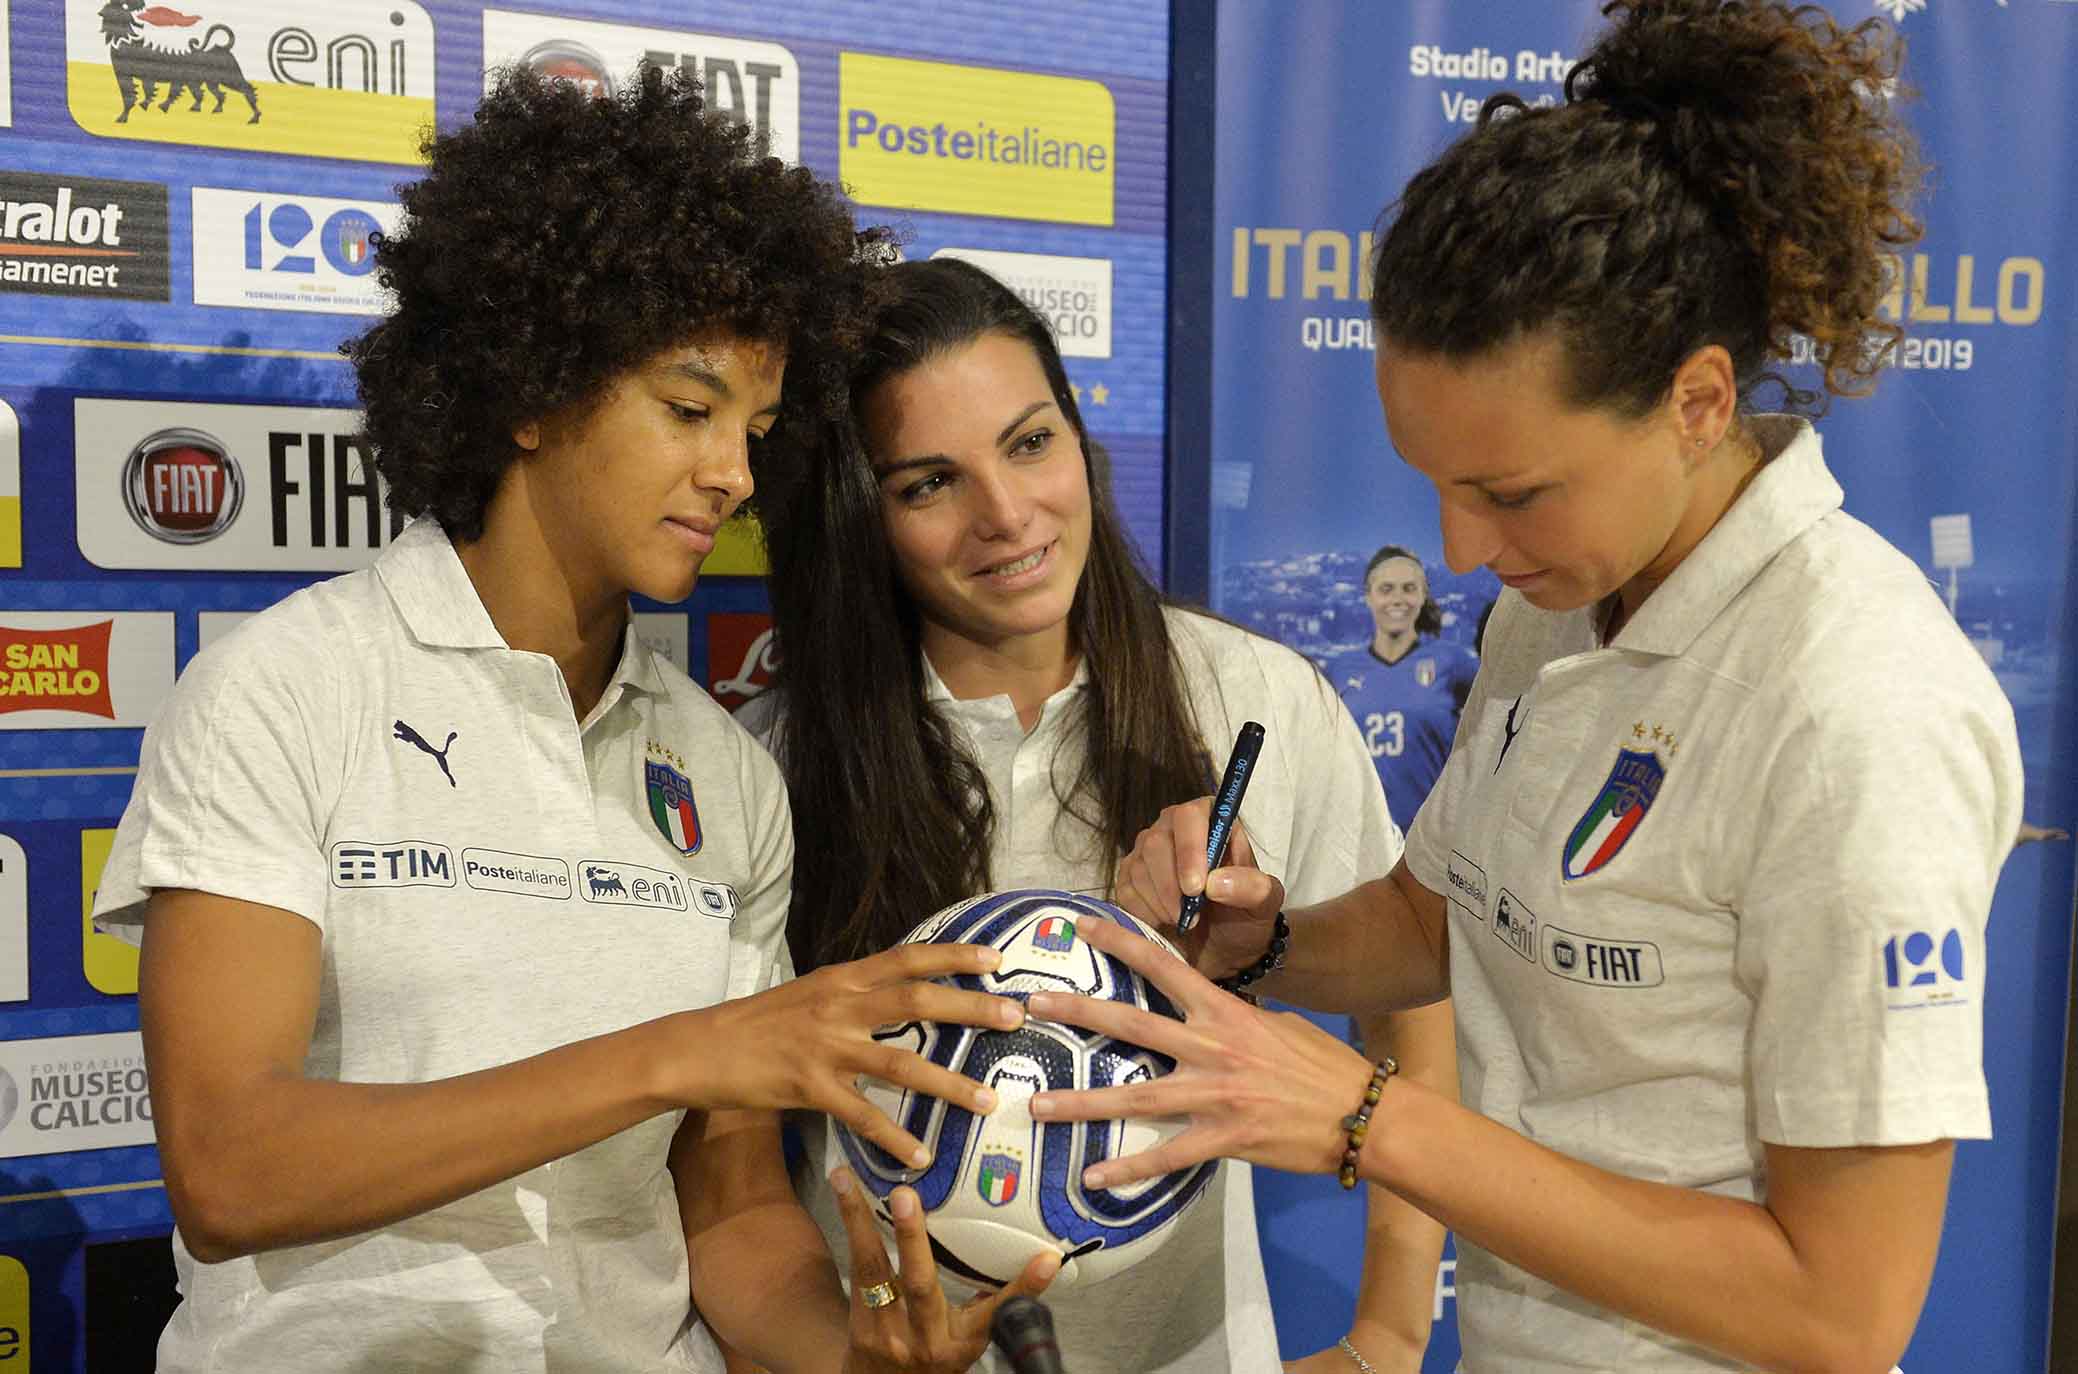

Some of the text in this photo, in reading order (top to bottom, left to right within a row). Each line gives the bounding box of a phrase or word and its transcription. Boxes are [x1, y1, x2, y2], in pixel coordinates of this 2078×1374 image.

[268, 11, 405, 96] eni
[1409, 45, 1508, 80] Stadio
[847, 109, 1107, 173] Posteitaliane
[244, 201, 386, 277] 120
[1903, 337, 1974, 370] 2019
[153, 463, 218, 513] FIAT
[6, 643, 79, 670] SAN
[1364, 711, 1405, 758] 23
[382, 848, 449, 880] TIM
[466, 861, 568, 887] Posteitaliane
[632, 875, 682, 906] eni
[1511, 917, 1534, 956] eni
[1586, 943, 1642, 982] FIAT
[31, 1068, 148, 1101] MUSEO
